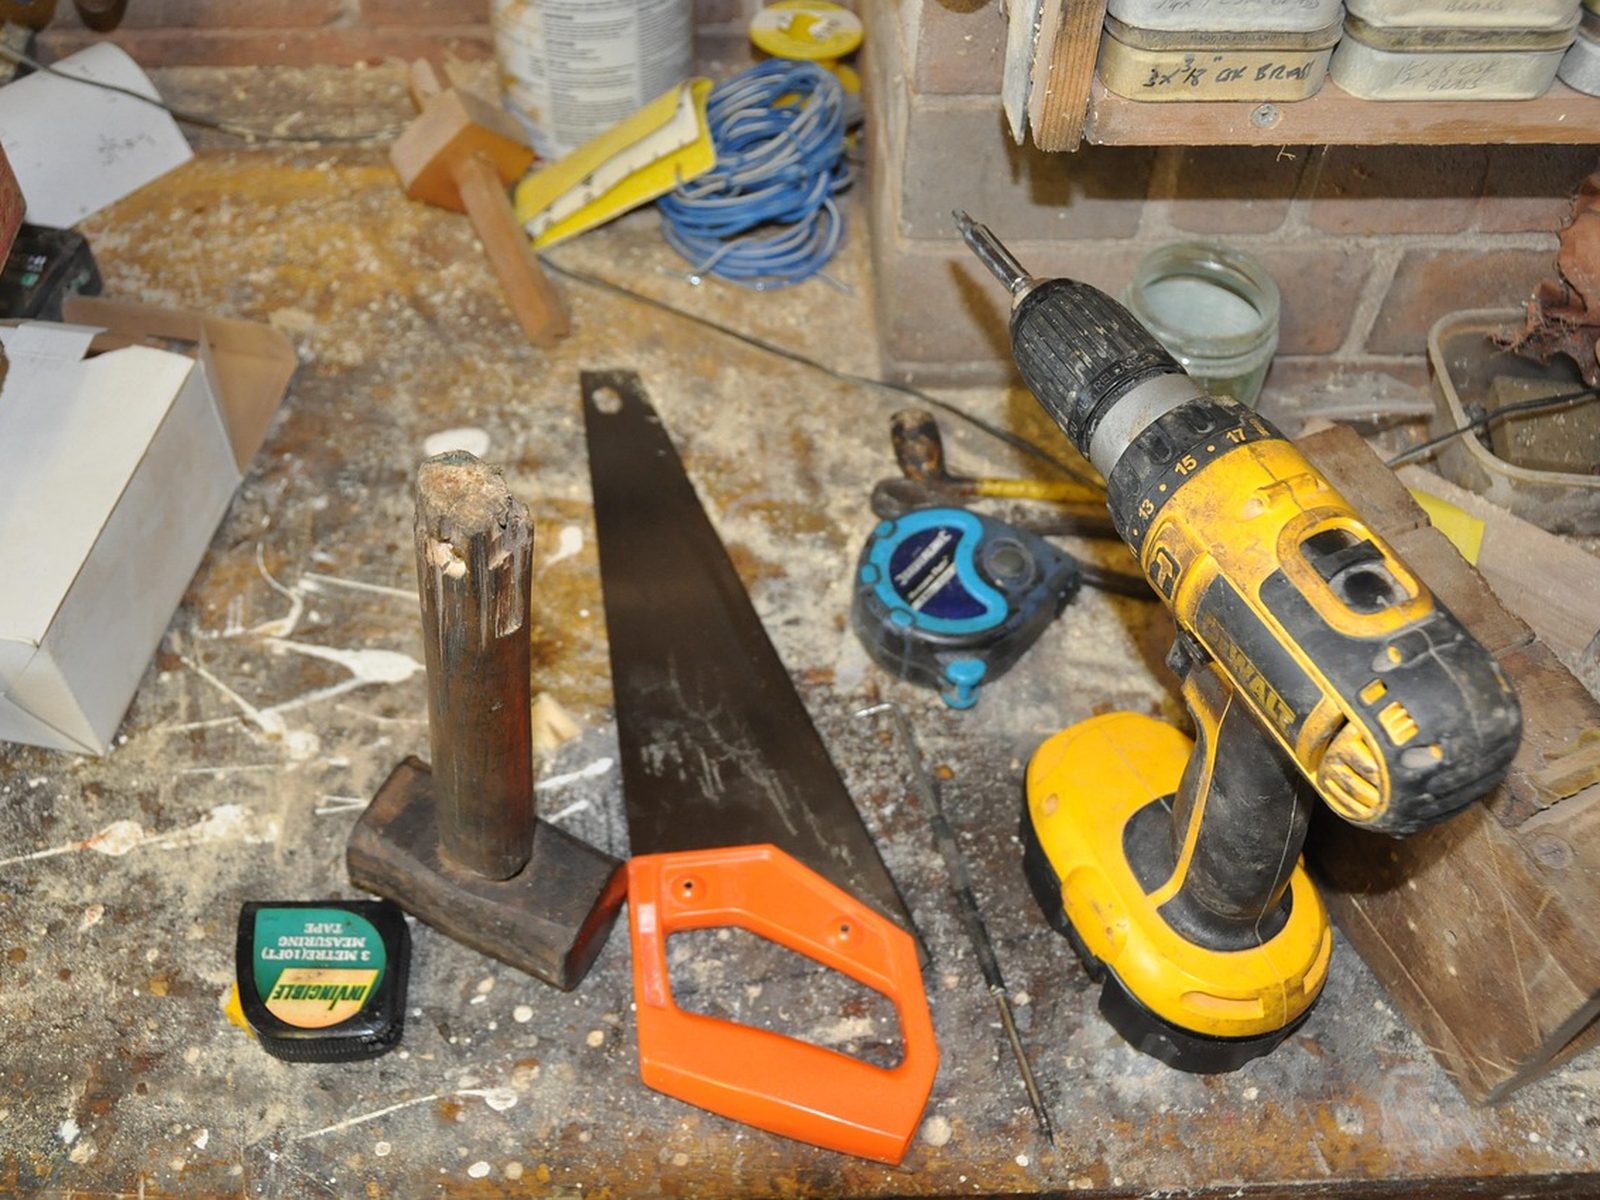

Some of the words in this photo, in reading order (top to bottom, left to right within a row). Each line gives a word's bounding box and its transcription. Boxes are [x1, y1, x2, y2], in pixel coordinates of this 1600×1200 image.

[1226, 428, 1247, 443] 17
[1174, 455, 1198, 476] 15
[1138, 499, 1155, 520] 13
[303, 923, 343, 934] TAPE
[277, 936, 366, 948] MEASURING
[361, 950, 371, 960] 3
[272, 984, 367, 1010] INVINCIBLE
